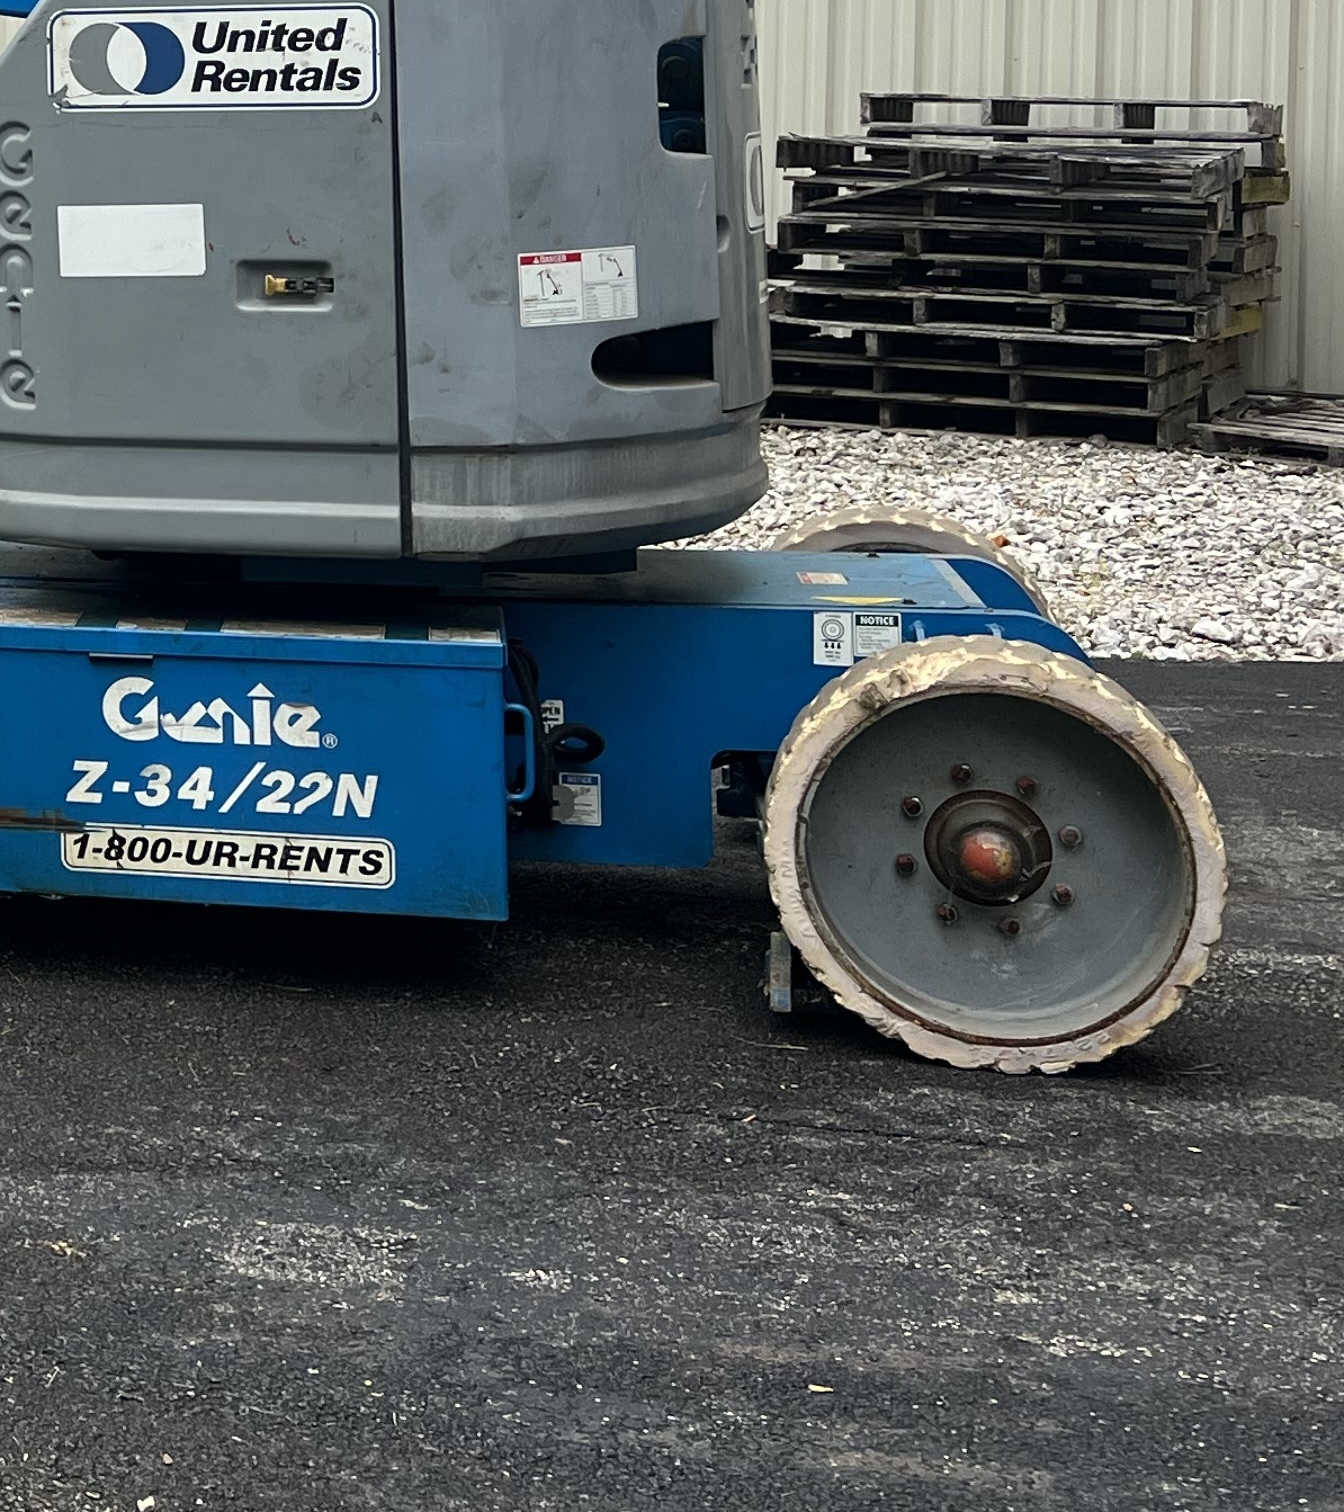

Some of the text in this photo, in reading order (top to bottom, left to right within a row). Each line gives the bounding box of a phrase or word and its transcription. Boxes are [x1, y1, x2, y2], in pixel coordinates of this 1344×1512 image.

[191, 17, 348, 54] United
[190, 58, 363, 92] Rentals
[859, 615, 895, 626] NOTICE
[72, 833, 386, 876] 1-800-UR-RENTS
